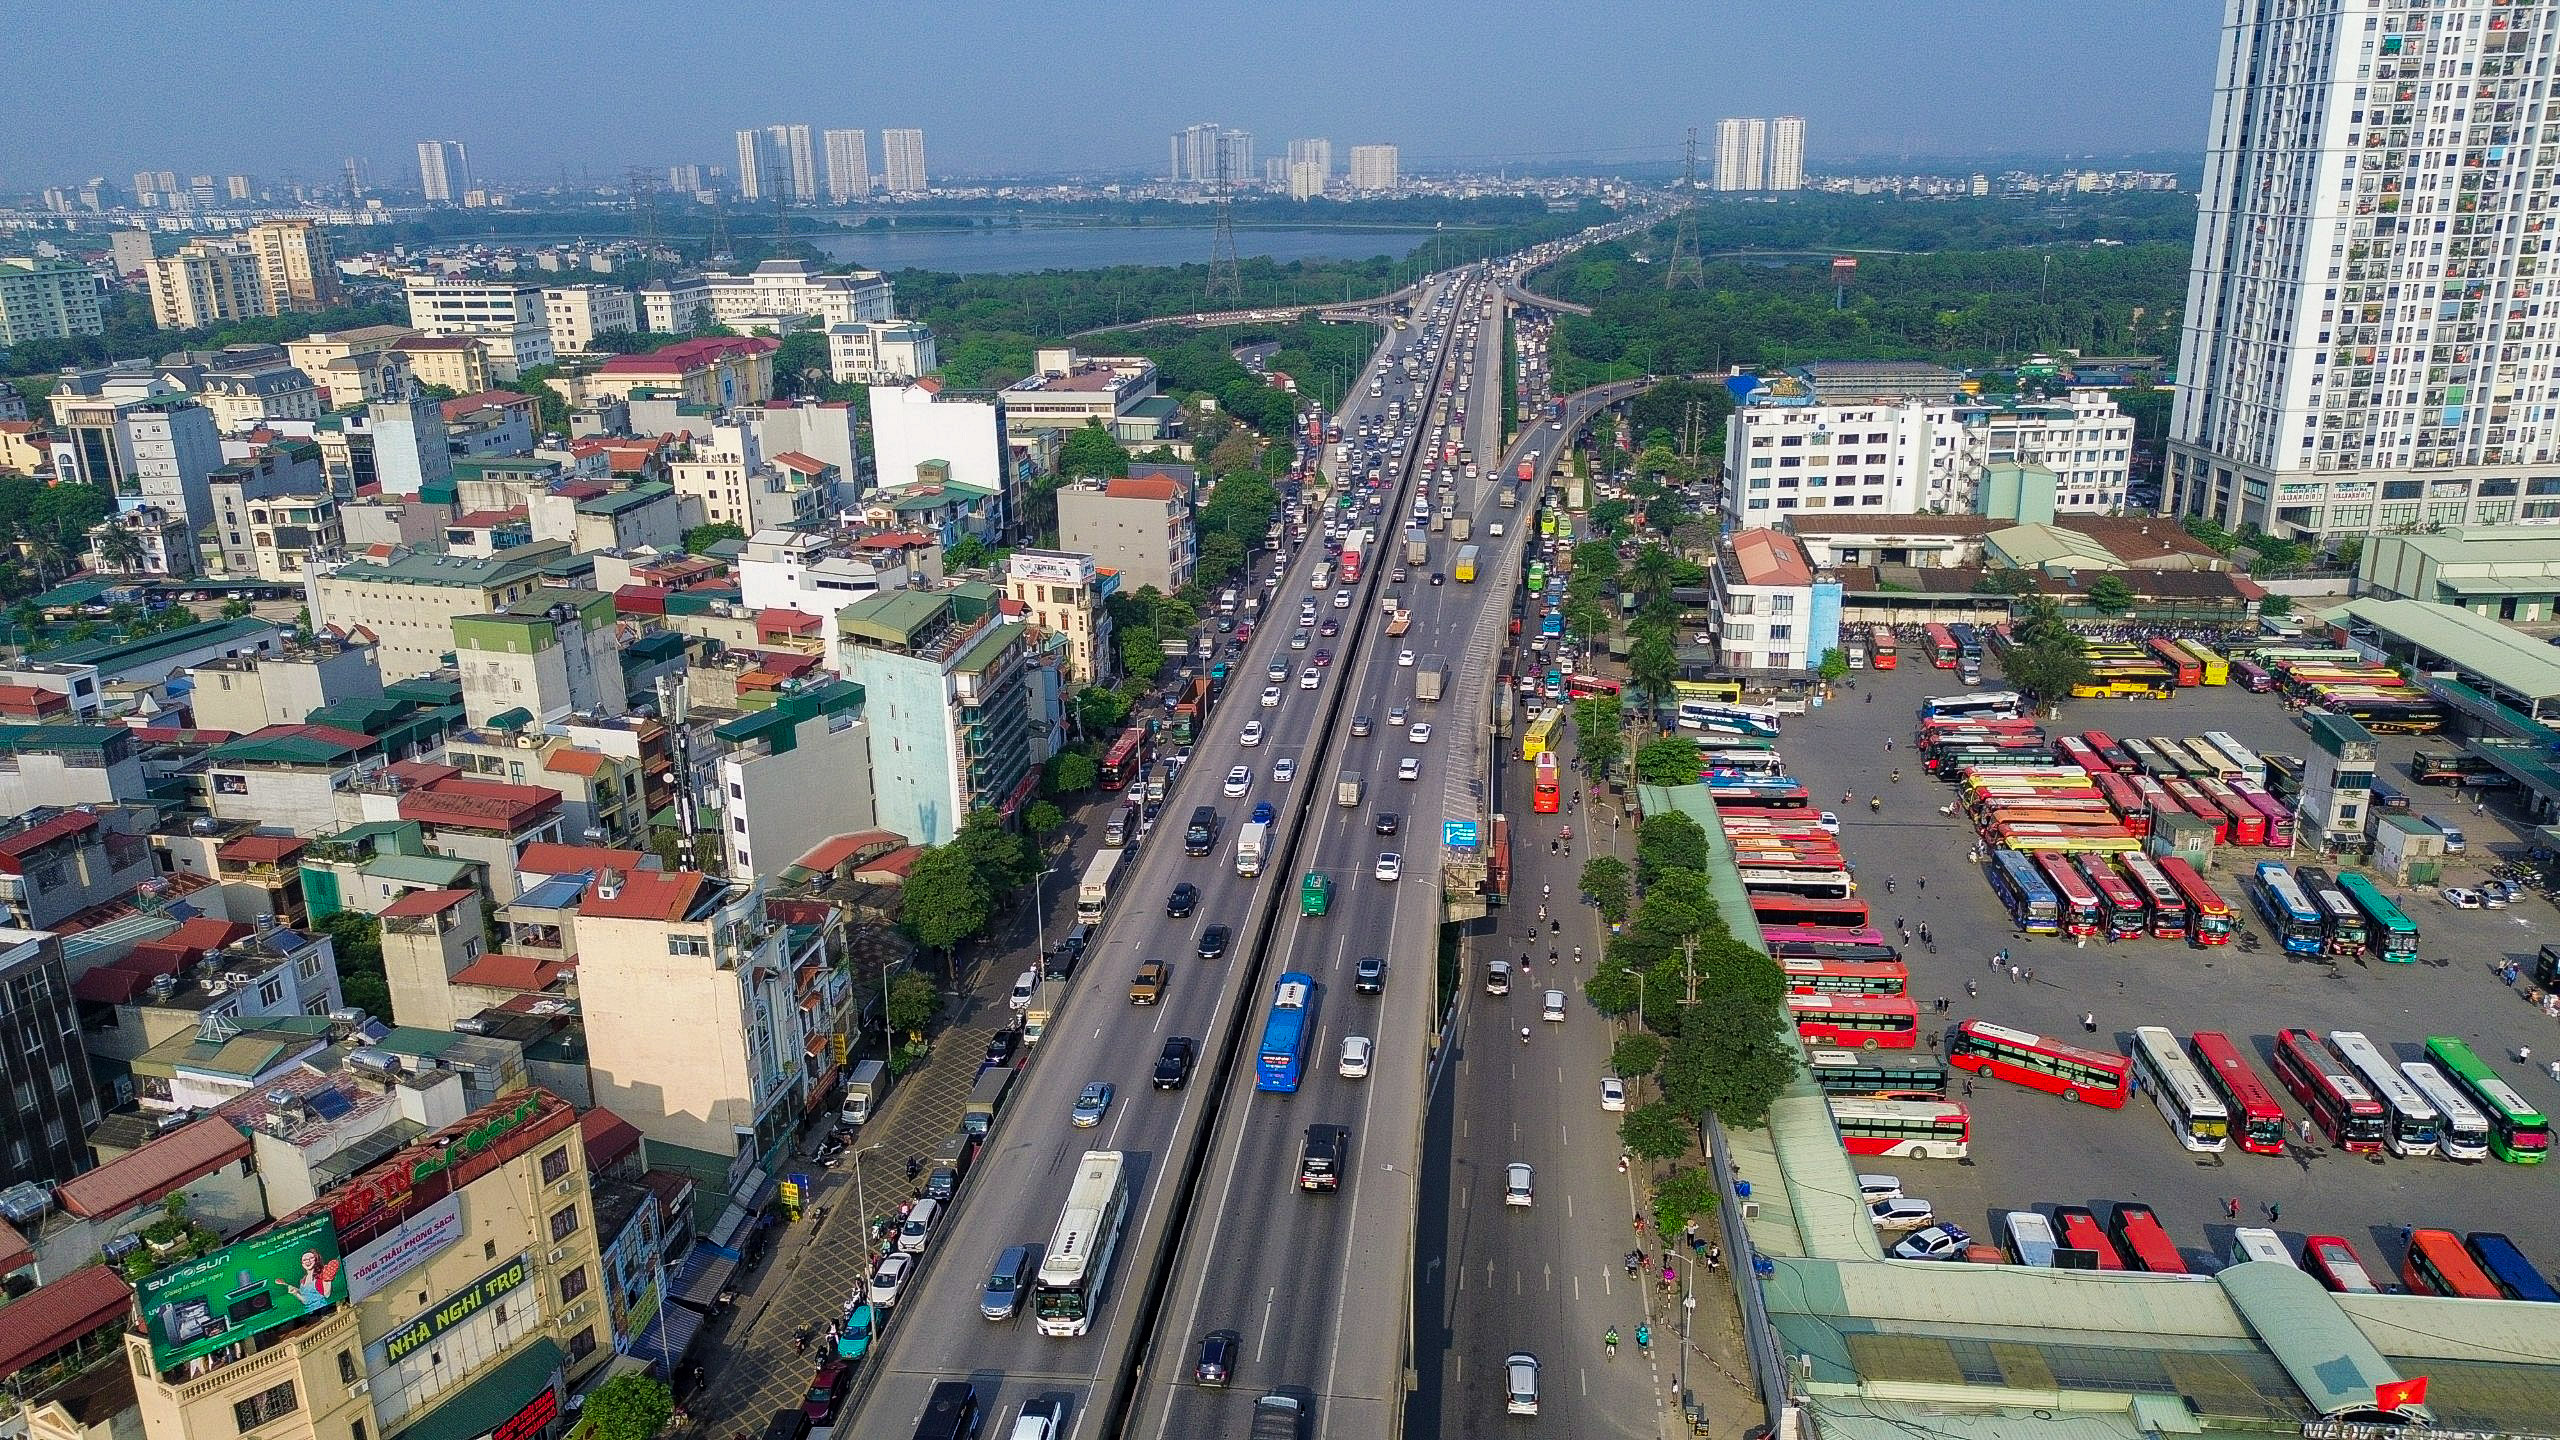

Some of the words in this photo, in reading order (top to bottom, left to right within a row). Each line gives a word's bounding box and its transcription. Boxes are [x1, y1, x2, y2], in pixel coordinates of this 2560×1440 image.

[404, 1228, 433, 1250] PHÒNG
[434, 1213, 456, 1234] SẠCH
[388, 1322, 432, 1361] NHÀ
[435, 1284, 482, 1331] NGHỈ
[485, 1264, 522, 1298] TRỌ
